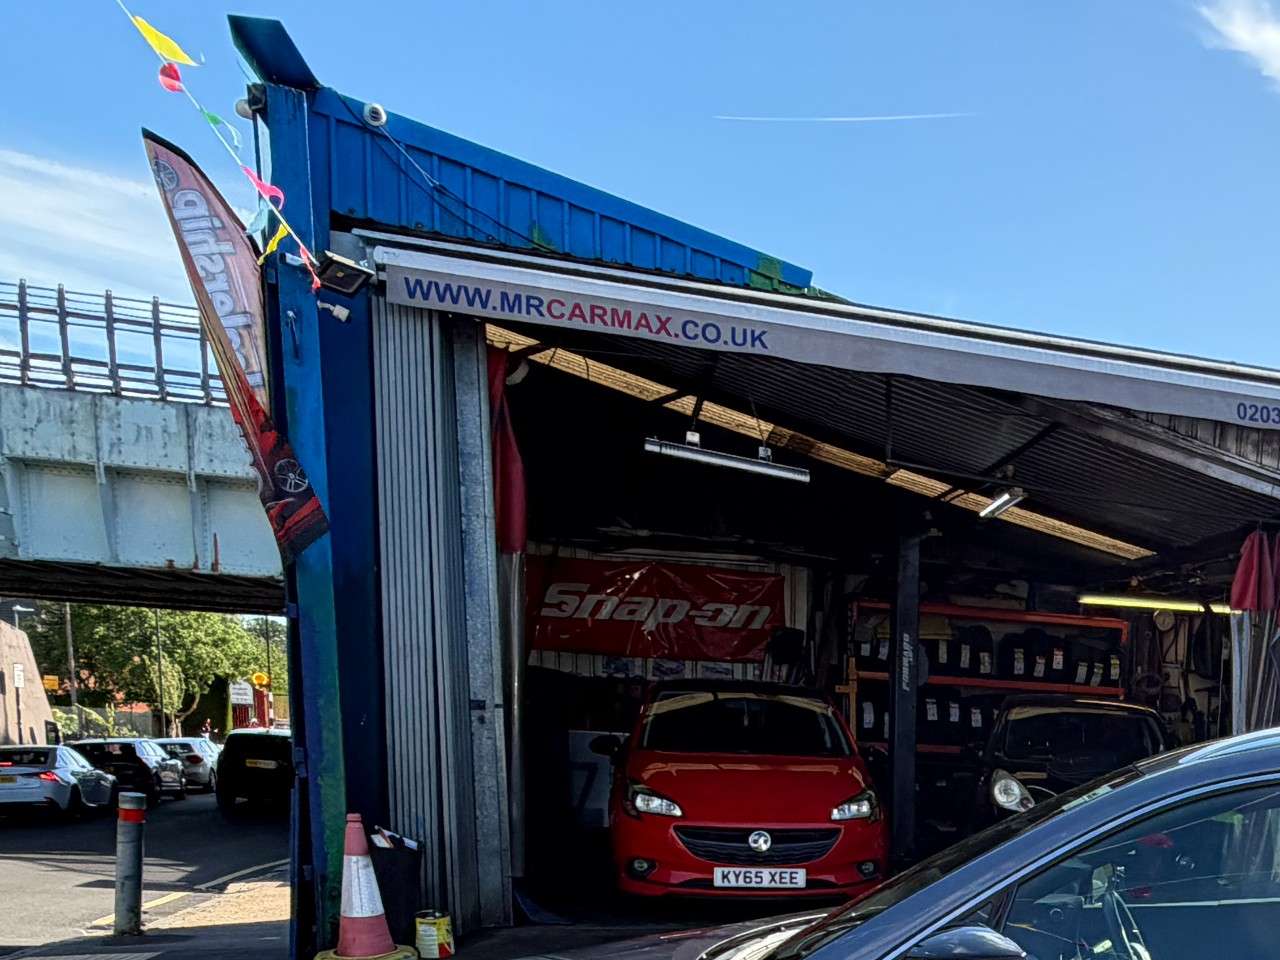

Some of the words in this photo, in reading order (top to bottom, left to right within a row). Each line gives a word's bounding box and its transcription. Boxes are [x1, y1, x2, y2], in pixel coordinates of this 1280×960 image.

[403, 276, 769, 350] WWW.MRCARMAX.CO.UK
[540, 582, 771, 632] Snap-on
[721, 870, 764, 885] KY65
[768, 871, 799, 885] XEE
